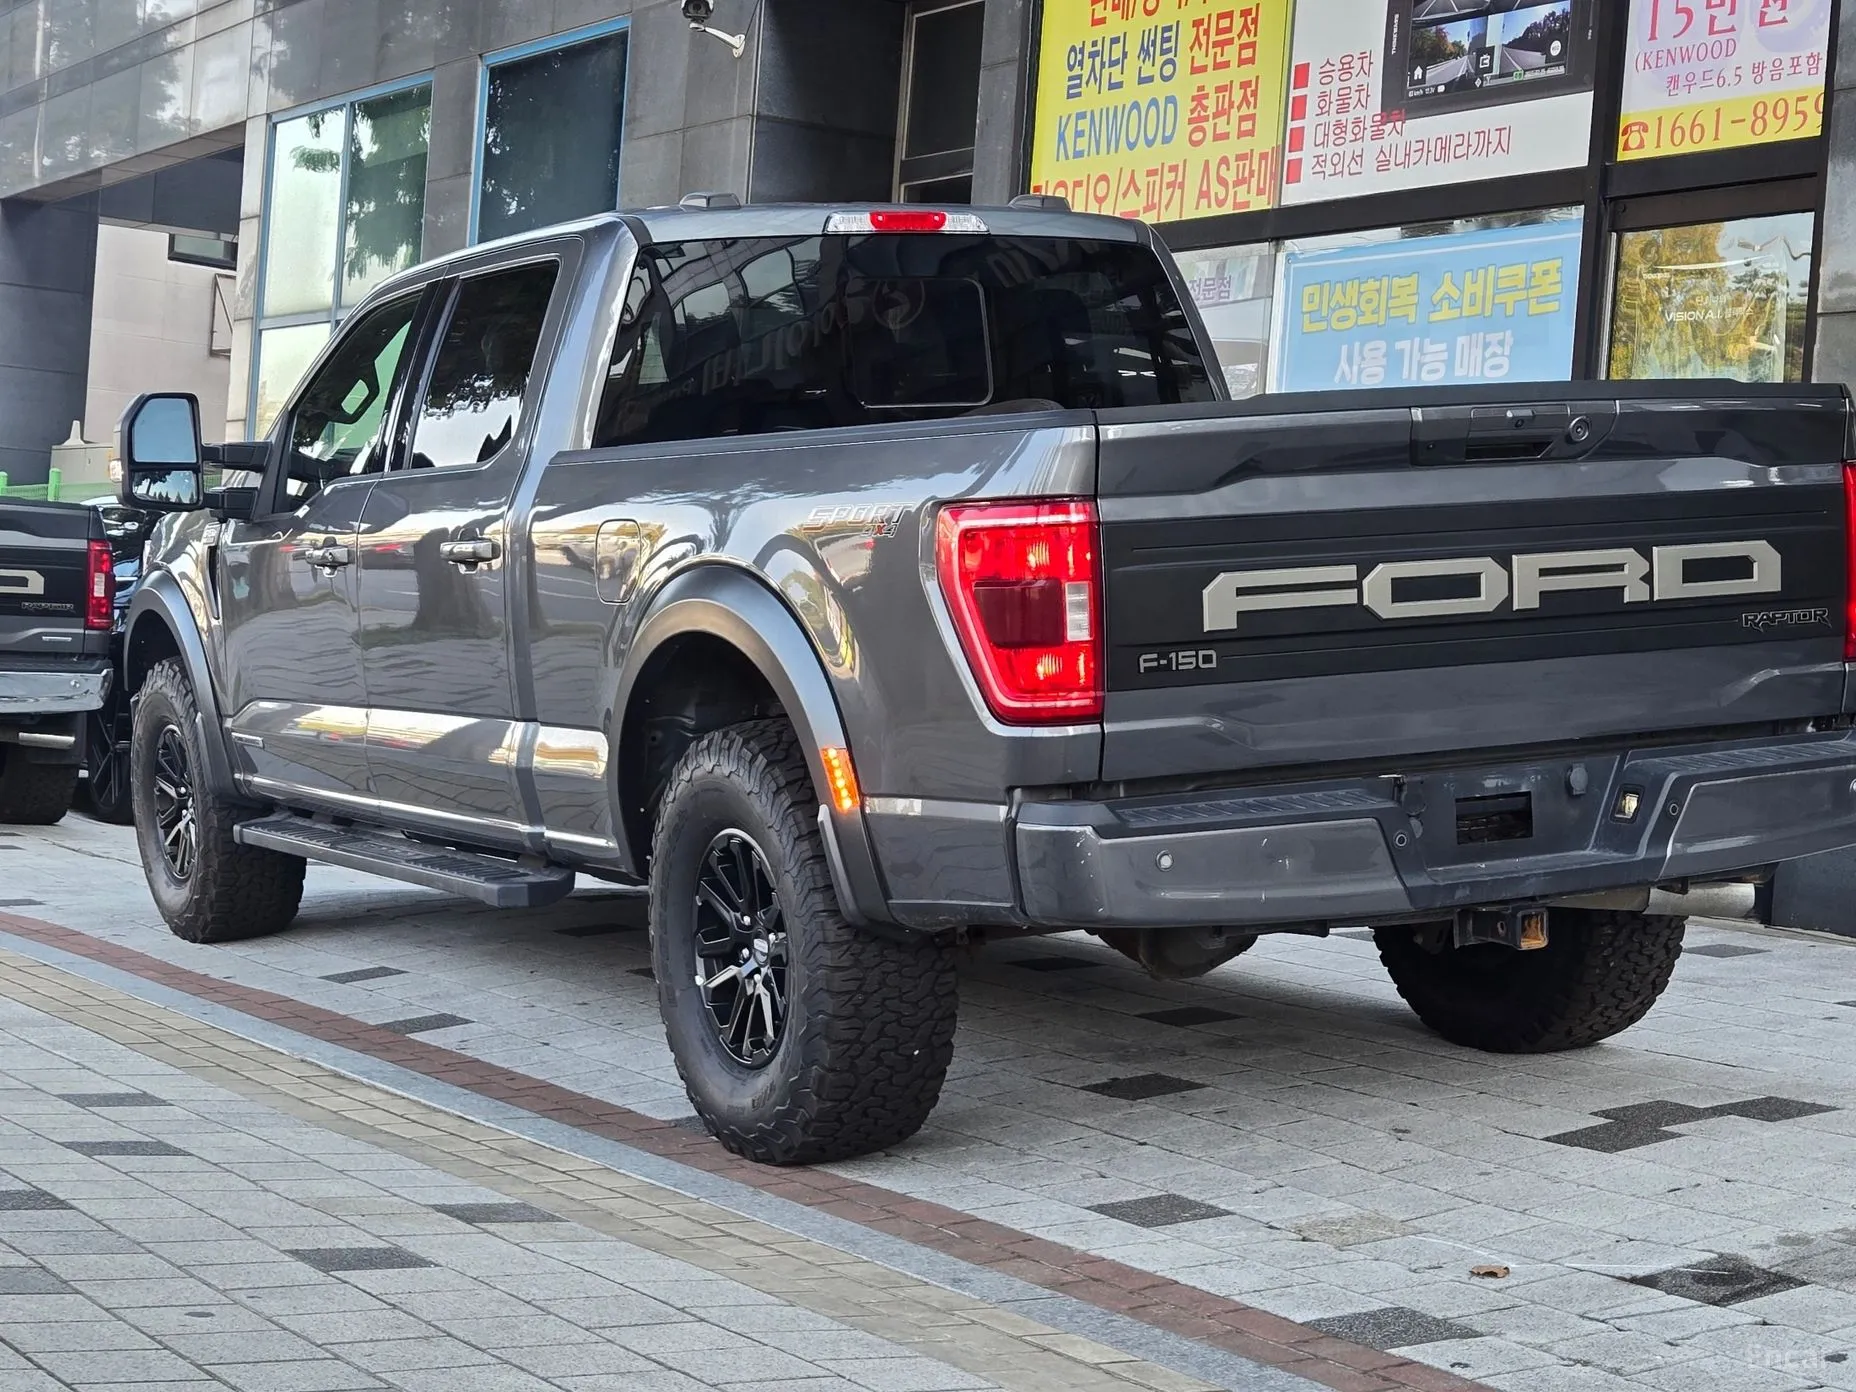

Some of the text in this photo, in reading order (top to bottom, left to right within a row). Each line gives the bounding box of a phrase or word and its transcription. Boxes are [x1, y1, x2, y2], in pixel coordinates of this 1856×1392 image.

[1066, 32, 1128, 99] 열차단
[1137, 20, 1180, 86] 썬팅
[1189, 3, 1260, 75] 전문점
[1318, 49, 1373, 82] 승용차
[1055, 75, 1260, 161] KENWOOD 총판점
[1315, 82, 1371, 117] 화물차
[1311, 125, 1513, 180] 적외선 실내카메라까지
[1313, 108, 1406, 149] 대형화물차
[1302, 257, 1563, 333] 민생회복 소비쿠폰
[1334, 330, 1513, 386] 사용 가능 매장
[1203, 540, 1782, 632] FORD
[1741, 607, 1833, 632] RAPTOR
[1137, 649, 1217, 673] F-150
